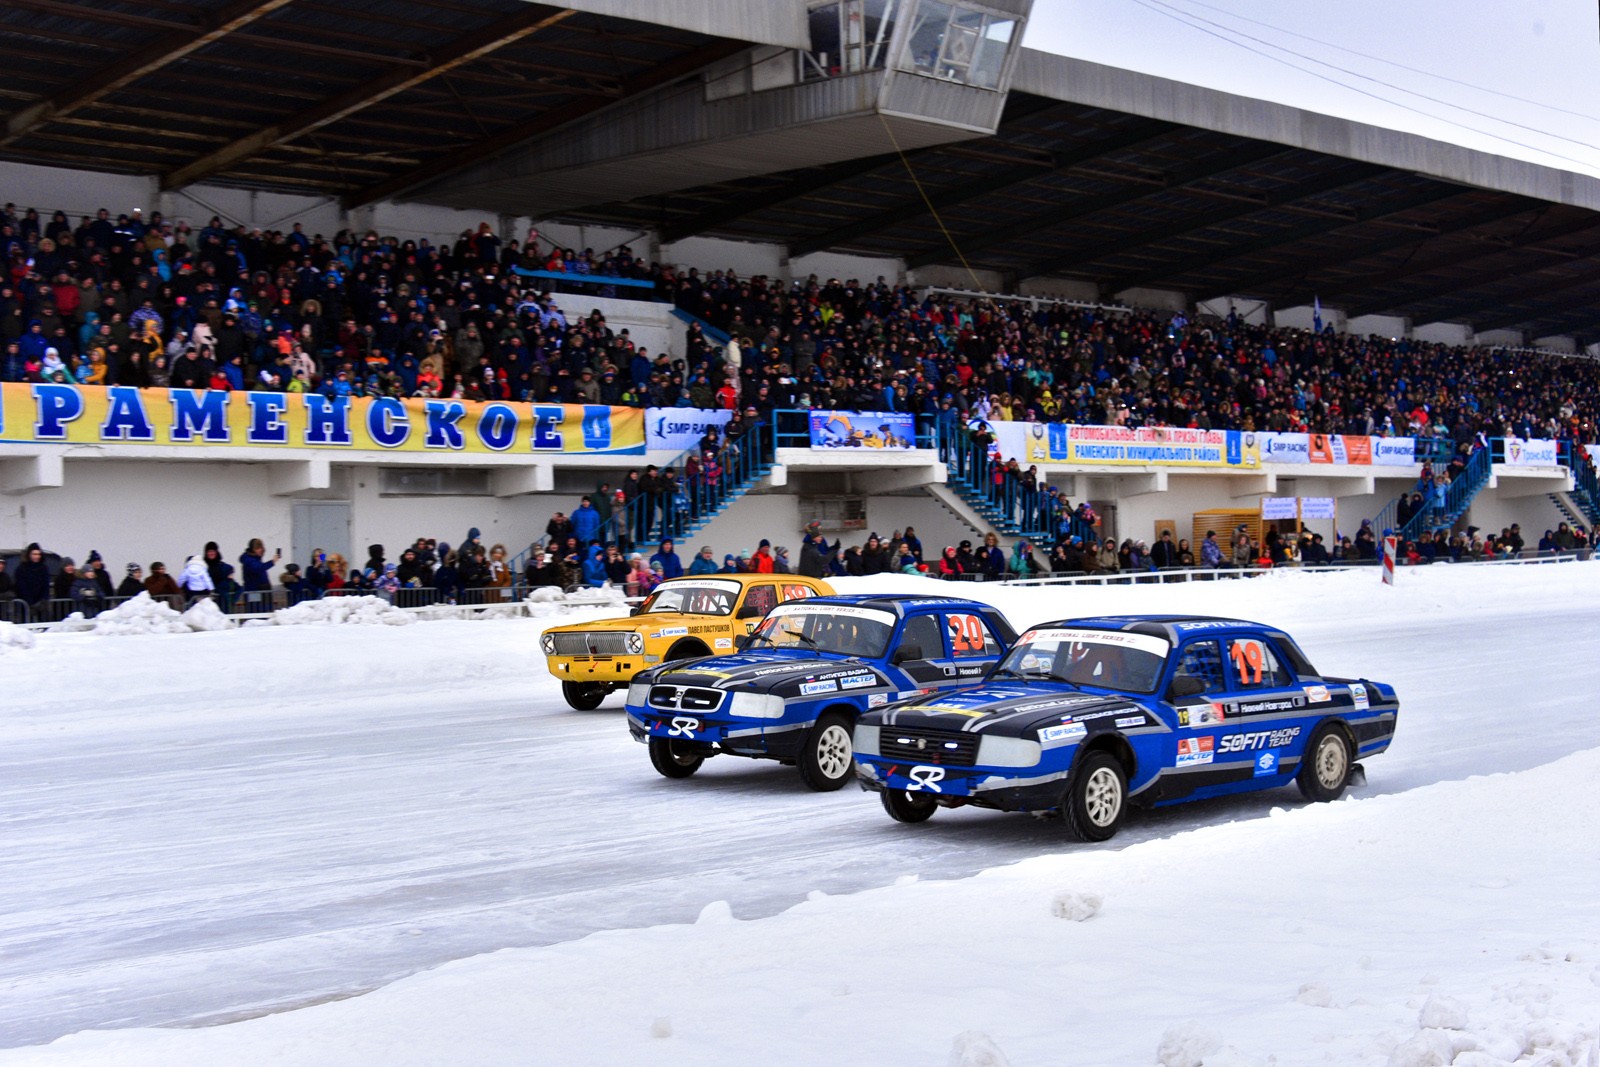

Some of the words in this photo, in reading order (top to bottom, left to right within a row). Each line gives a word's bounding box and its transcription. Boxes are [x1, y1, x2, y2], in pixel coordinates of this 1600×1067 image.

[32, 384, 564, 451] РАМЕНСКОЕ
[667, 423, 690, 434] SMP
[1070, 427, 1136, 441] АВТОМОБИЛЬНЫЕ
[1075, 445, 1124, 459] РАМЕНСКОГО
[1127, 446, 1192, 461] МУНИЦИПАЛЬНОГО
[1194, 446, 1220, 461] РАЙОНА
[1273, 443, 1286, 451] SMP
[1287, 444, 1307, 452] RACING
[1381, 446, 1393, 454] SMP
[1394, 446, 1414, 455] RACING
[688, 626, 702, 634] ПАВЕЛ
[704, 625, 730, 633] ПАСТУШКОВ
[949, 615, 984, 651] 20
[1101, 634, 1124, 642] SERIES
[1231, 642, 1263, 685] 19
[820, 671, 847, 680] АНТИПОВ
[847, 668, 868, 676] ВАДИМ
[1241, 703, 1265, 713] Нижний
[1265, 701, 1293, 711] Новгород
[1178, 711, 1189, 724] 19
[668, 716, 699, 739] SR
[1050, 729, 1062, 738] SMP
[1062, 726, 1087, 736] RACING
[1270, 727, 1300, 739] RACING
[1217, 732, 1271, 754] SOFIT
[1268, 735, 1293, 748] TEAM
[906, 765, 945, 793] SR
